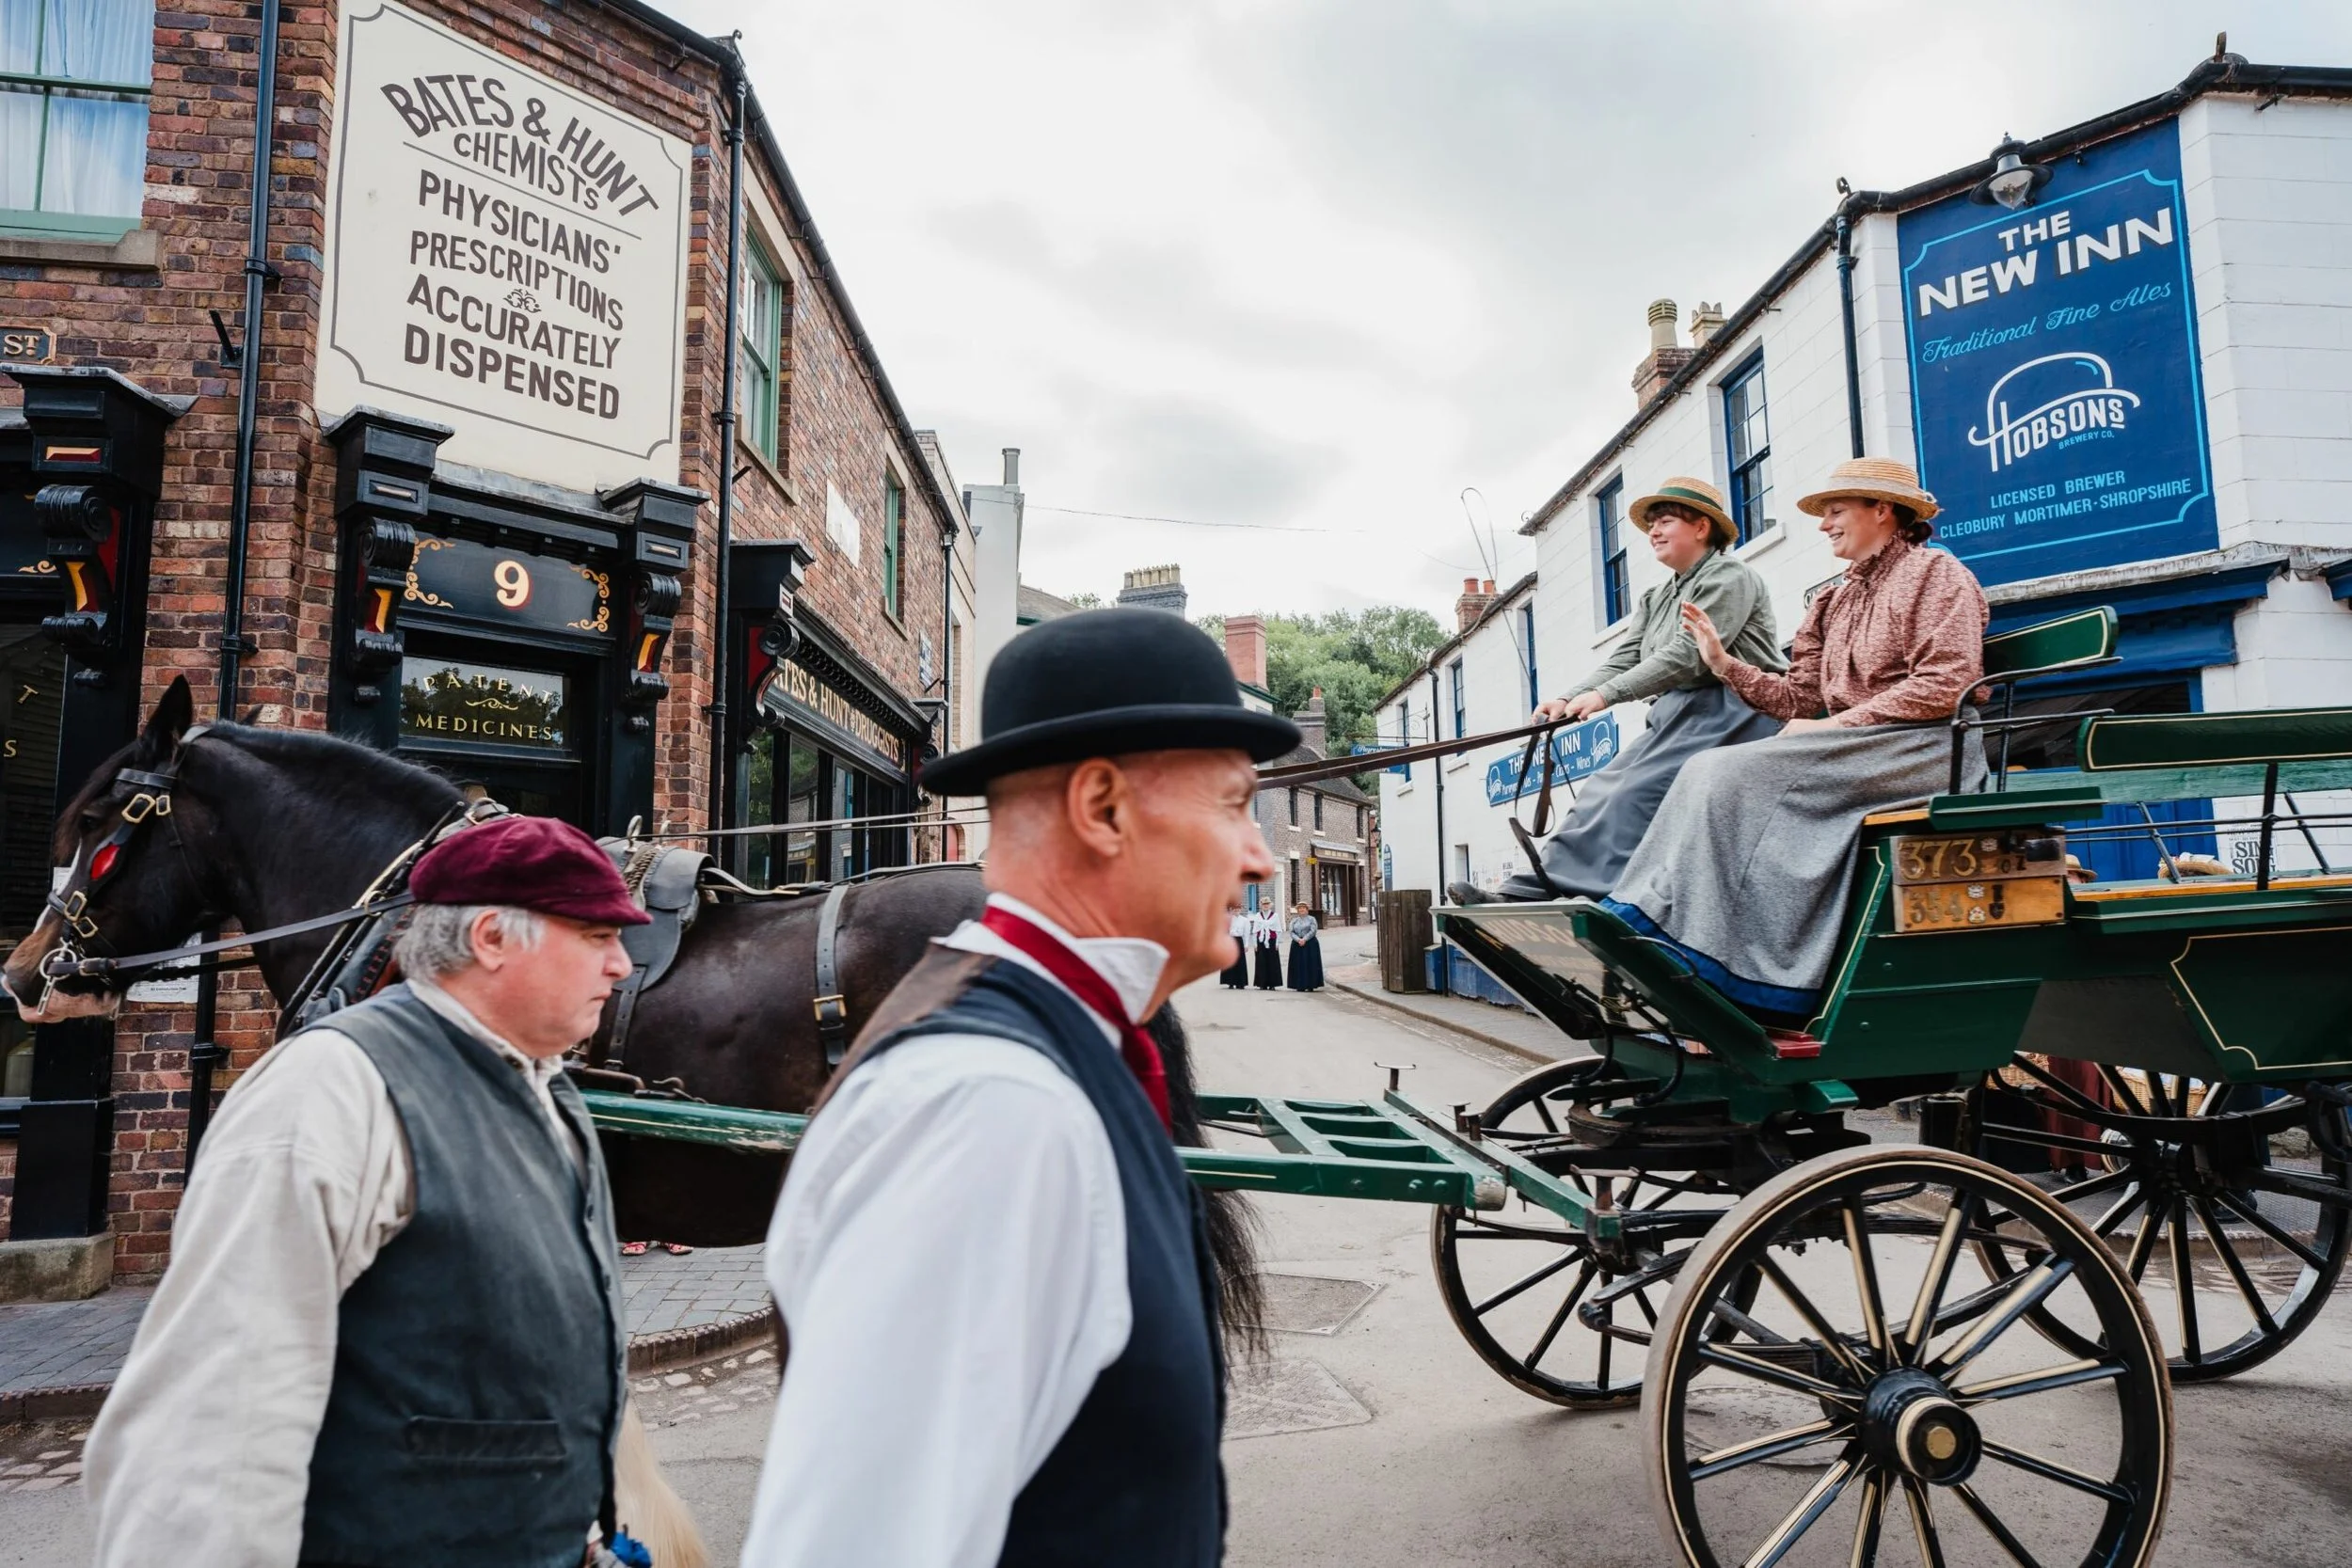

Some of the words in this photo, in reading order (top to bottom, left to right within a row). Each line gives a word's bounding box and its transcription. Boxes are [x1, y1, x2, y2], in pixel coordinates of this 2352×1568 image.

[380, 74, 514, 138] BATES
[523, 98, 550, 144] &
[557, 118, 659, 219] HUNT
[453, 132, 598, 211] CHEMISTS
[419, 169, 622, 273] PHYSICIANS'
[1998, 211, 2071, 251] THE
[410, 230, 624, 331] PRESCRIPTIONS
[1919, 249, 2038, 316] NEW
[2058, 207, 2173, 275] INN
[406, 274, 621, 369] ACCURATELY
[1923, 316, 2037, 362] Traditional
[2046, 304, 2100, 329] Fine
[2110, 282, 2171, 311] Ales
[405, 323, 619, 420] DISPENSED
[1970, 399, 2125, 472] HOBSONS
[2058, 431, 2099, 450] BREWERY
[1940, 515, 2006, 539] CLEOBURY
[1991, 484, 2056, 509] LICENSED
[2065, 470, 2125, 495] BREWER
[494, 560, 532, 609] 9
[423, 672, 552, 705] PATENT
[809, 675, 818, 708] &
[820, 682, 850, 730] HUNT
[855, 709, 899, 763] DRUGGISTS
[416, 714, 552, 740] MEDICINES
[1533, 741, 1552, 768] NE
[1561, 730, 1581, 757] INN
